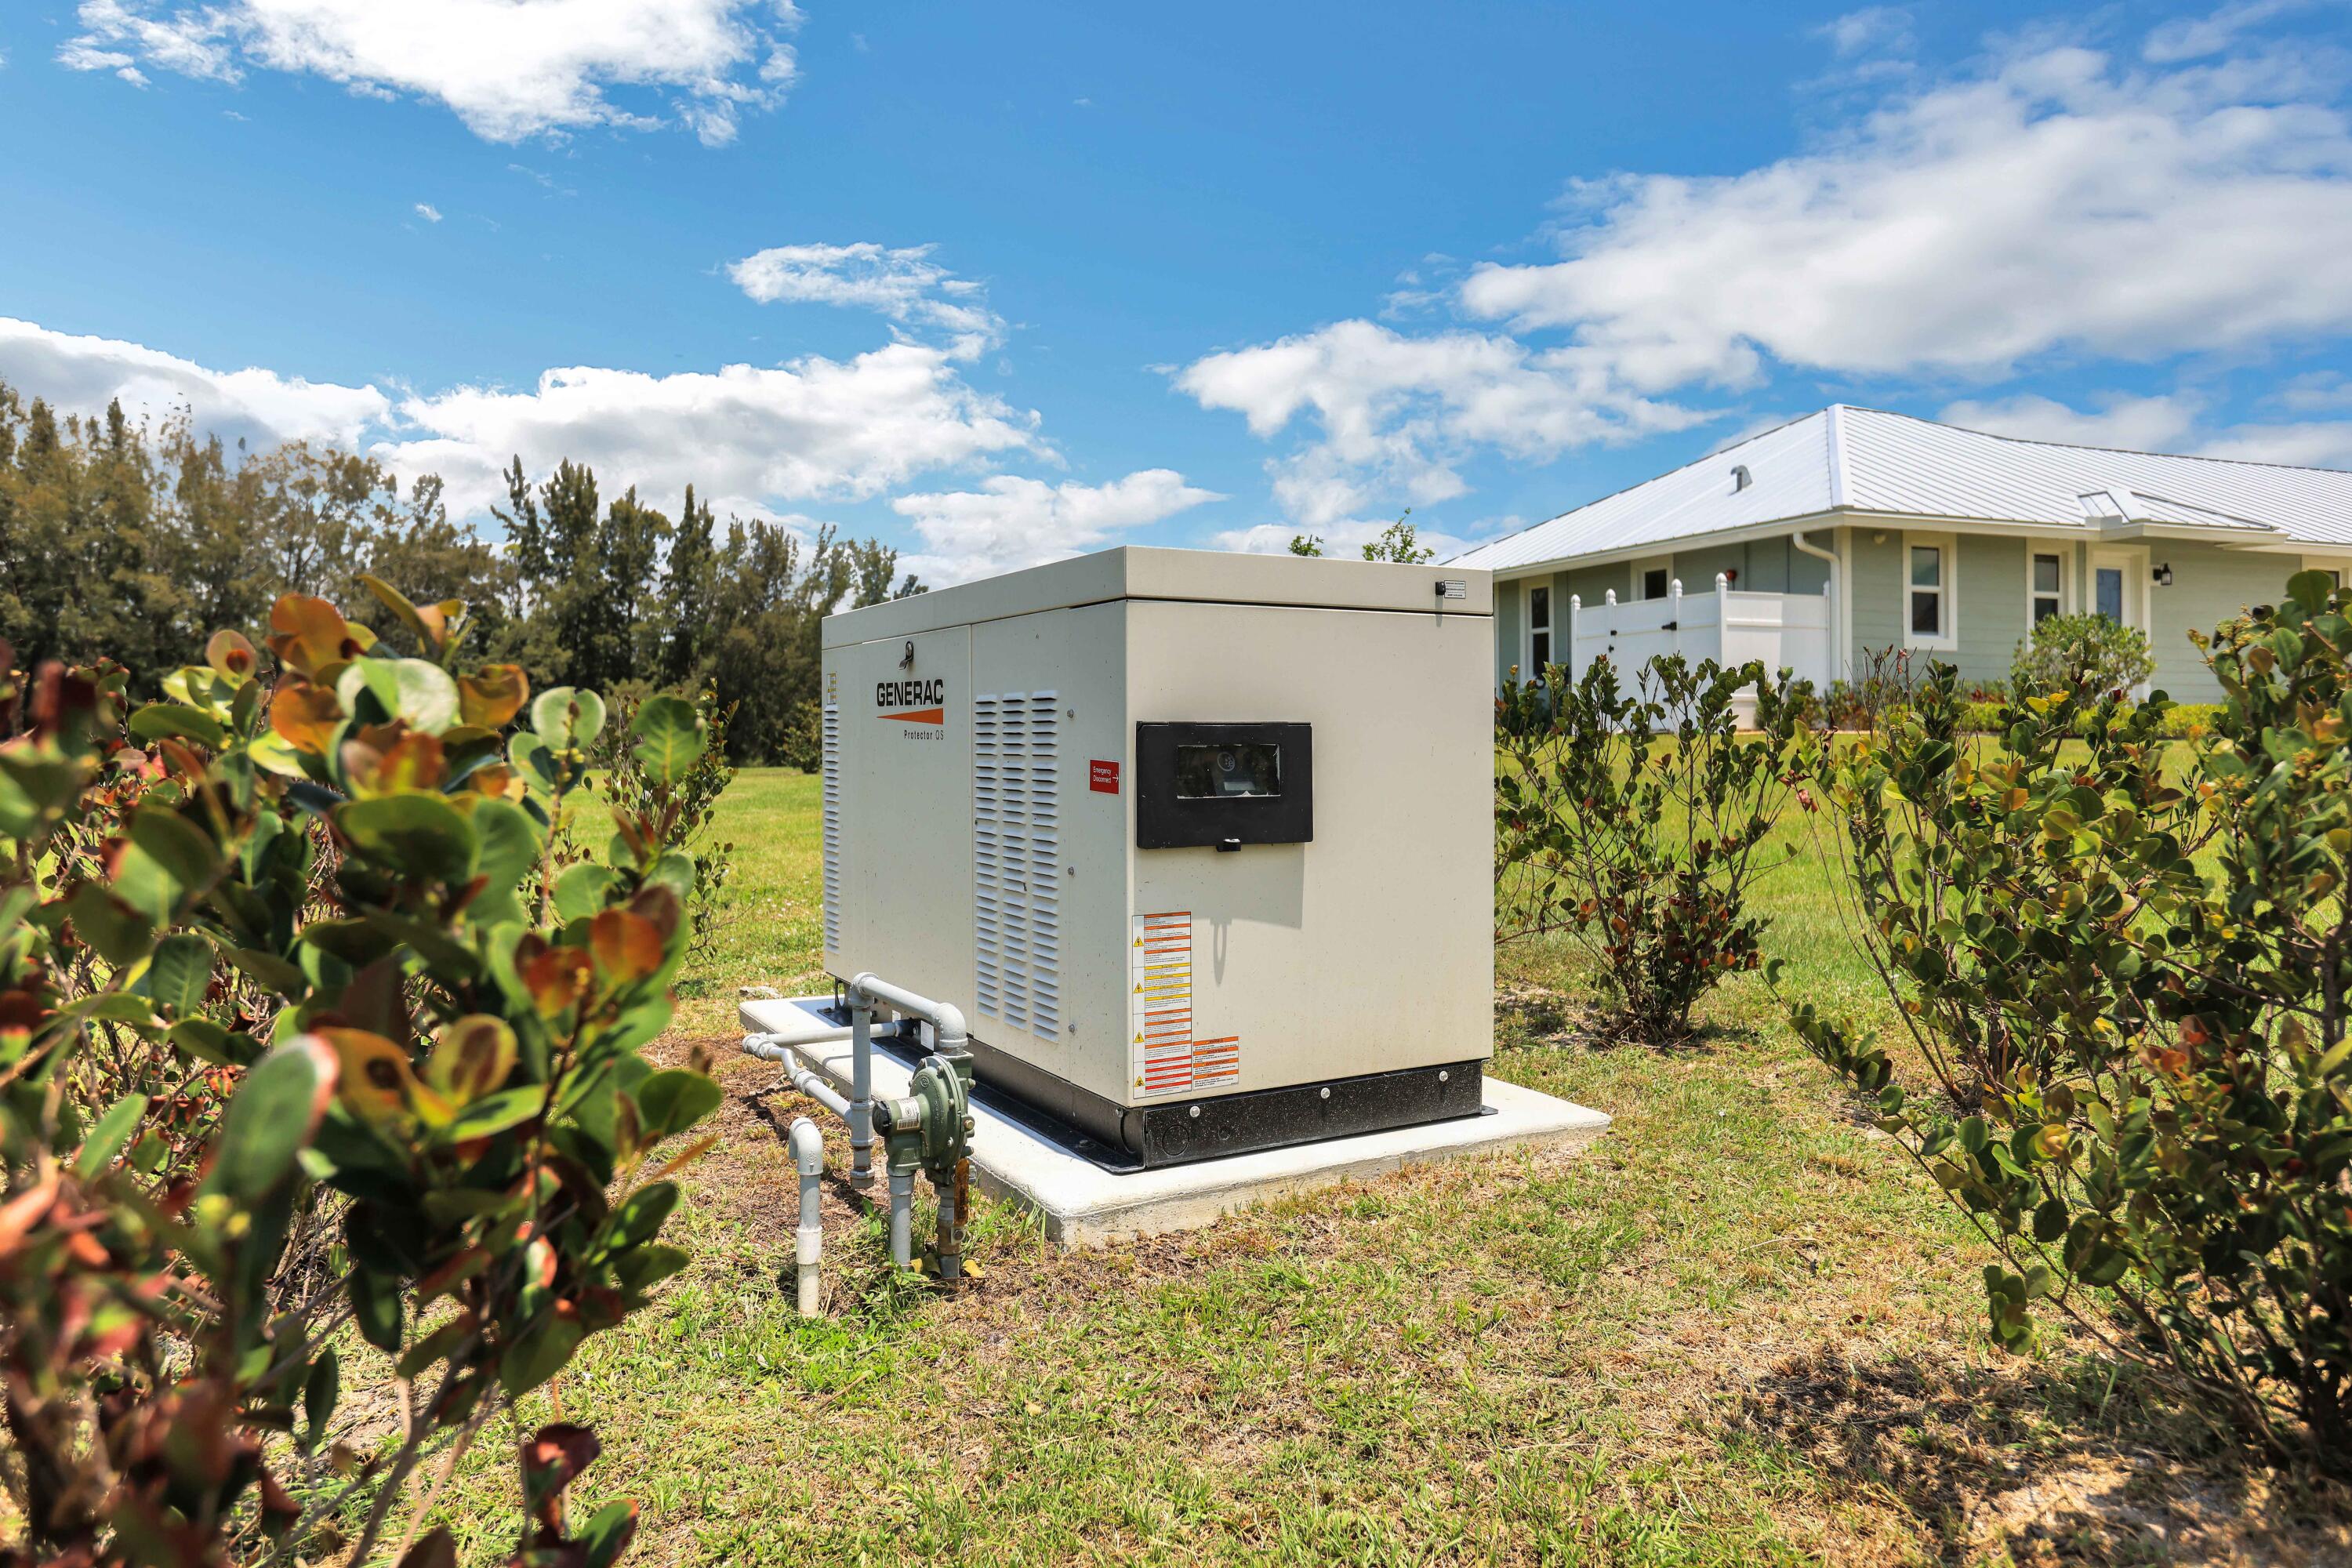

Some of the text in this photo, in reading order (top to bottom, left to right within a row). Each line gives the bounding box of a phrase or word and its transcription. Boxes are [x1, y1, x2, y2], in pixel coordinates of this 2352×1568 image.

[877, 679, 944, 707] GENERAC
[904, 730, 944, 740] Protector QS
[1093, 766, 1111, 776] Emergency
[1093, 775, 1111, 783] Disconnect
